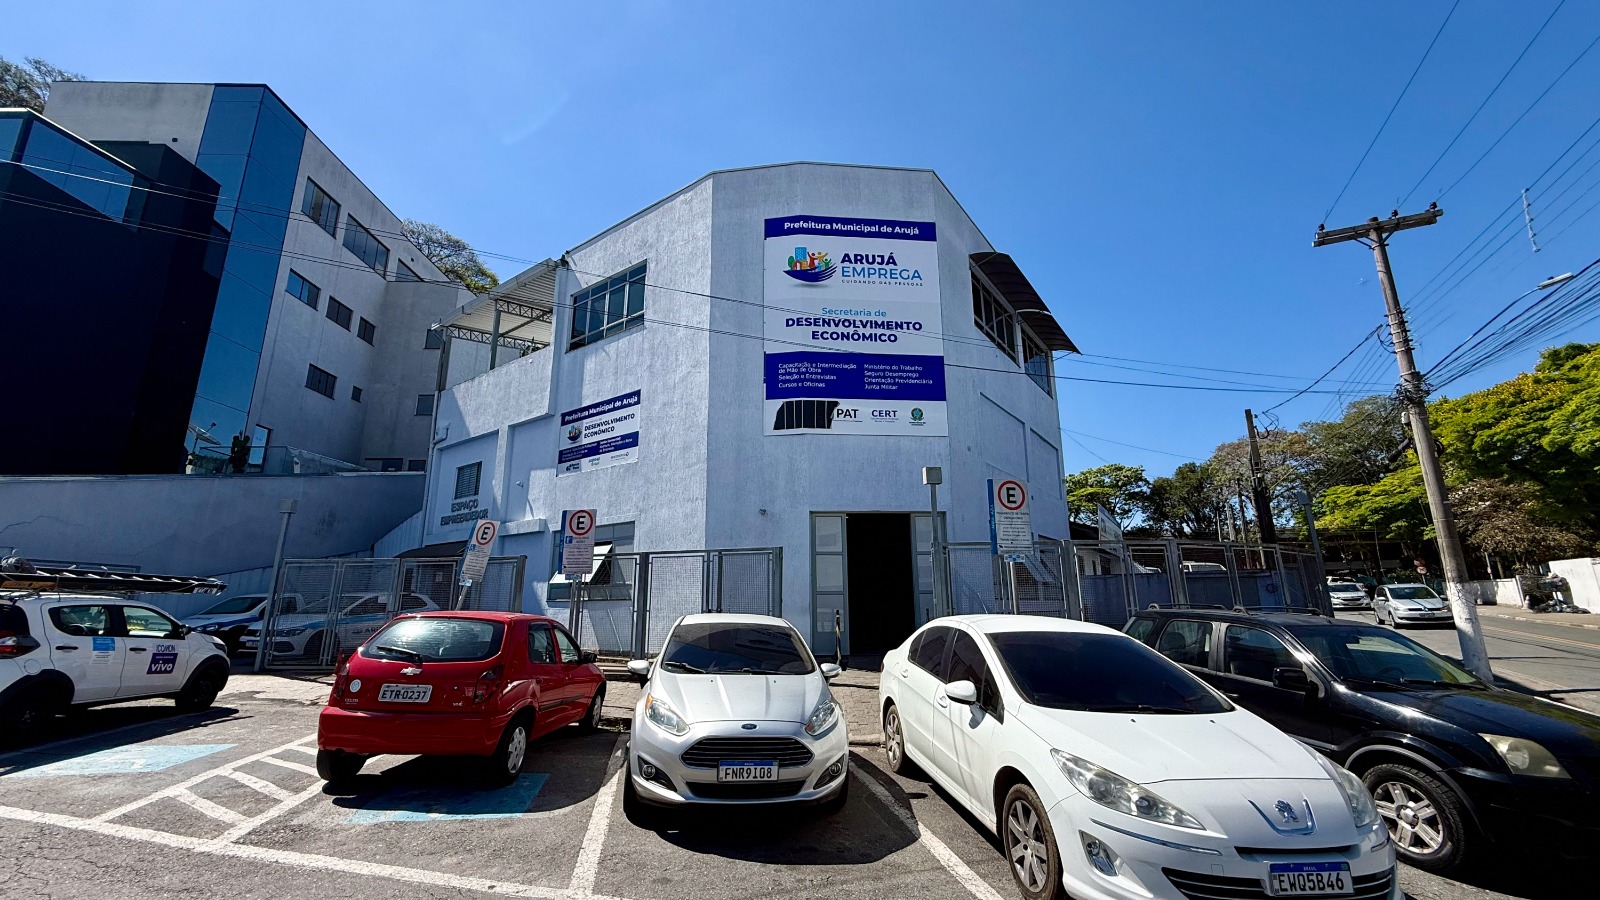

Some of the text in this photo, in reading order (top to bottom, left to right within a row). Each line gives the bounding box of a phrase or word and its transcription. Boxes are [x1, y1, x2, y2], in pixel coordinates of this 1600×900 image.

[784, 220, 919, 235] Prefeitura Municipal de Arujá
[840, 252, 898, 266] ARUJÁ
[842, 266, 922, 281] EMPREGA
[822, 307, 887, 317] Secretaria de
[785, 317, 922, 331] DESENVOLVIMENTO
[811, 330, 898, 342] ECONÔMICO
[564, 411, 589, 422] Prefeitura
[589, 402, 613, 414] Municipal
[622, 395, 638, 406] Arujá
[836, 409, 898, 418] PAT CERT
[584, 413, 635, 431] DESENVOLVIMENTO
[584, 426, 615, 439] ECONÔMICO
[1006, 487, 1016, 504] E
[451, 498, 478, 512] ESPAÇO
[440, 508, 488, 526] EMPREENDEDOR
[576, 516, 586, 530] E
[481, 527, 490, 540] E
[152, 660, 173, 671] vivo
[724, 767, 772, 779] FNR9I08
[1278, 872, 1344, 892] EWQ5B46
